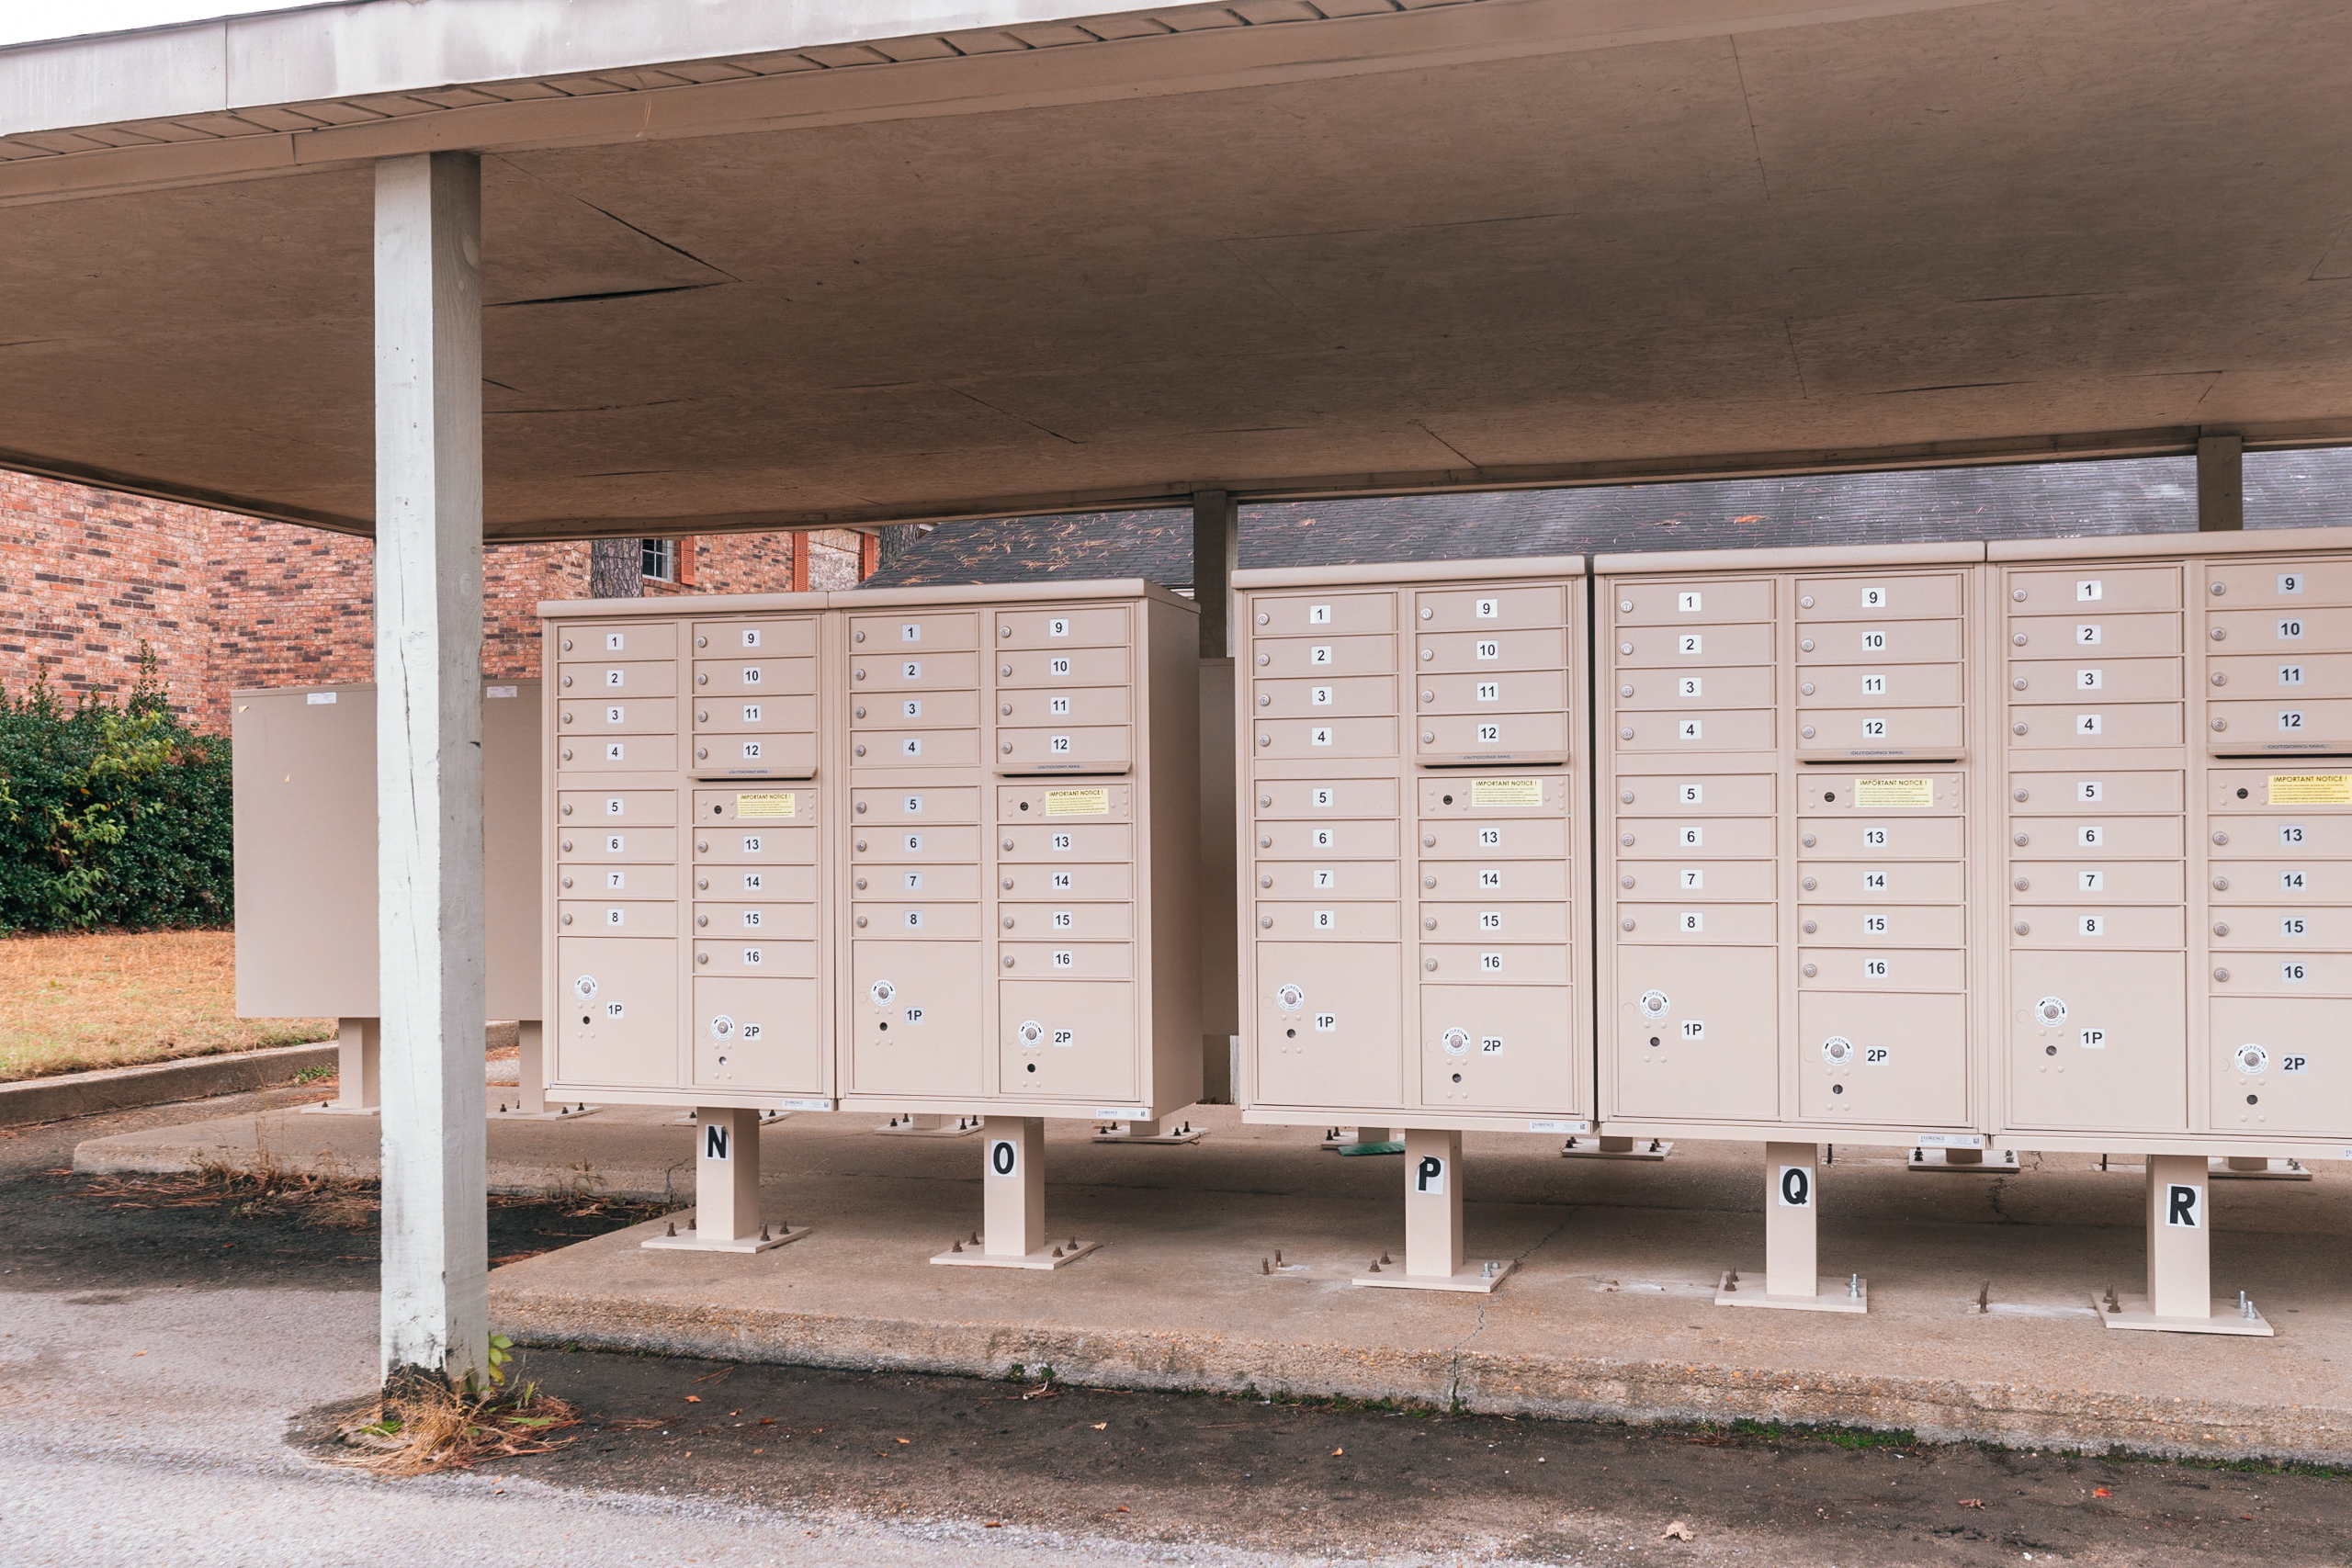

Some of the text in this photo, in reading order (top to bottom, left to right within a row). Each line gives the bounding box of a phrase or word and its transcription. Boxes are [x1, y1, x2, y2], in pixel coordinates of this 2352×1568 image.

[2084, 584, 2093, 596] 1
[2285, 577, 2295, 591] 9
[1686, 596, 1693, 608] 1
[1869, 592, 1878, 604] 9
[1316, 609, 1324, 620] 1
[1482, 603, 1491, 615] 9
[907, 626, 914, 638] 1
[1055, 622, 1063, 634] 9
[2280, 622, 2301, 636] 10
[747, 633, 755, 644] 9
[2084, 628, 2093, 641] 2
[611, 637, 618, 647] 1
[1686, 638, 1694, 650] 2
[1865, 635, 1883, 648] 10
[1317, 649, 1326, 661] 2
[1479, 644, 1496, 656] 10
[907, 664, 916, 676] 2
[1053, 660, 1068, 671] 10
[610, 672, 619, 683] 2
[745, 670, 759, 682] 10
[2085, 672, 2094, 685] 3
[2281, 668, 2300, 682] 11
[1686, 681, 1694, 694] 3
[1865, 678, 1881, 691] 11
[1317, 690, 1327, 702] 3
[1480, 685, 1494, 697] 11
[908, 703, 917, 715] 3
[1053, 700, 1066, 711] 11
[611, 709, 619, 720] 3
[745, 707, 758, 719] 11
[2084, 717, 2094, 730] 4
[2281, 714, 2301, 728] 12
[1481, 727, 1497, 739] 12
[1686, 724, 1695, 736] 4
[1866, 722, 1883, 734] 12
[1317, 731, 1326, 742] 4
[745, 745, 759, 756] 12
[908, 741, 916, 752] 4
[1054, 739, 1068, 750] 12
[610, 747, 619, 757] 4
[1687, 788, 1695, 800] 5
[2086, 784, 2095, 797] 5
[909, 798, 918, 810] 5
[1318, 792, 1328, 804] 5
[611, 802, 619, 812] 5
[1318, 832, 1327, 844] 6
[1482, 831, 1498, 843] 13
[1687, 830, 1695, 843] 6
[1867, 831, 1884, 844] 13
[2086, 829, 2095, 842] 6
[2283, 829, 2302, 841] 13
[611, 839, 619, 850] 6
[746, 839, 759, 851] 13
[909, 837, 918, 849] 6
[1055, 836, 1069, 848] 13
[612, 874, 620, 886] 7
[746, 876, 760, 887] 14
[909, 875, 918, 886] 7
[1055, 874, 1069, 886] 14
[1319, 873, 1328, 885] 7
[1482, 873, 1498, 885] 14
[1687, 874, 1696, 886] 7
[1867, 874, 1884, 887] 14
[2086, 874, 2096, 887] 7
[2284, 874, 2303, 887] 14
[611, 912, 619, 922] 8
[746, 913, 759, 925] 15
[910, 913, 918, 925] 8
[1056, 914, 1070, 926] 15
[1319, 914, 1329, 926] 8
[1483, 915, 1499, 927] 15
[1687, 916, 1696, 929] 8
[1867, 918, 1884, 931] 15
[2086, 919, 2096, 932] 8
[2284, 919, 2304, 933] 15
[746, 951, 760, 963] 16
[1056, 953, 1070, 964] 16
[1484, 956, 1500, 968] 16
[1868, 962, 1885, 975] 16
[2284, 965, 2304, 979] 16
[2047, 998, 2063, 1007] OPEN
[608, 1004, 622, 1015] 1P
[907, 1010, 922, 1021] 1P
[1317, 1016, 1334, 1028] 1P
[744, 1026, 760, 1037] 2P
[1684, 1023, 1702, 1035] 1P
[1055, 1032, 1071, 1043] 2P
[2083, 1032, 2103, 1044] 1P
[1483, 1040, 1501, 1052] 2P
[1867, 1049, 1887, 1062] 2P
[2284, 1057, 2305, 1070] 2P
[707, 1125, 729, 1159] N
[1418, 1156, 1442, 1191] P
[1781, 1168, 1808, 1205] Q
[2169, 1185, 2196, 1226] R
